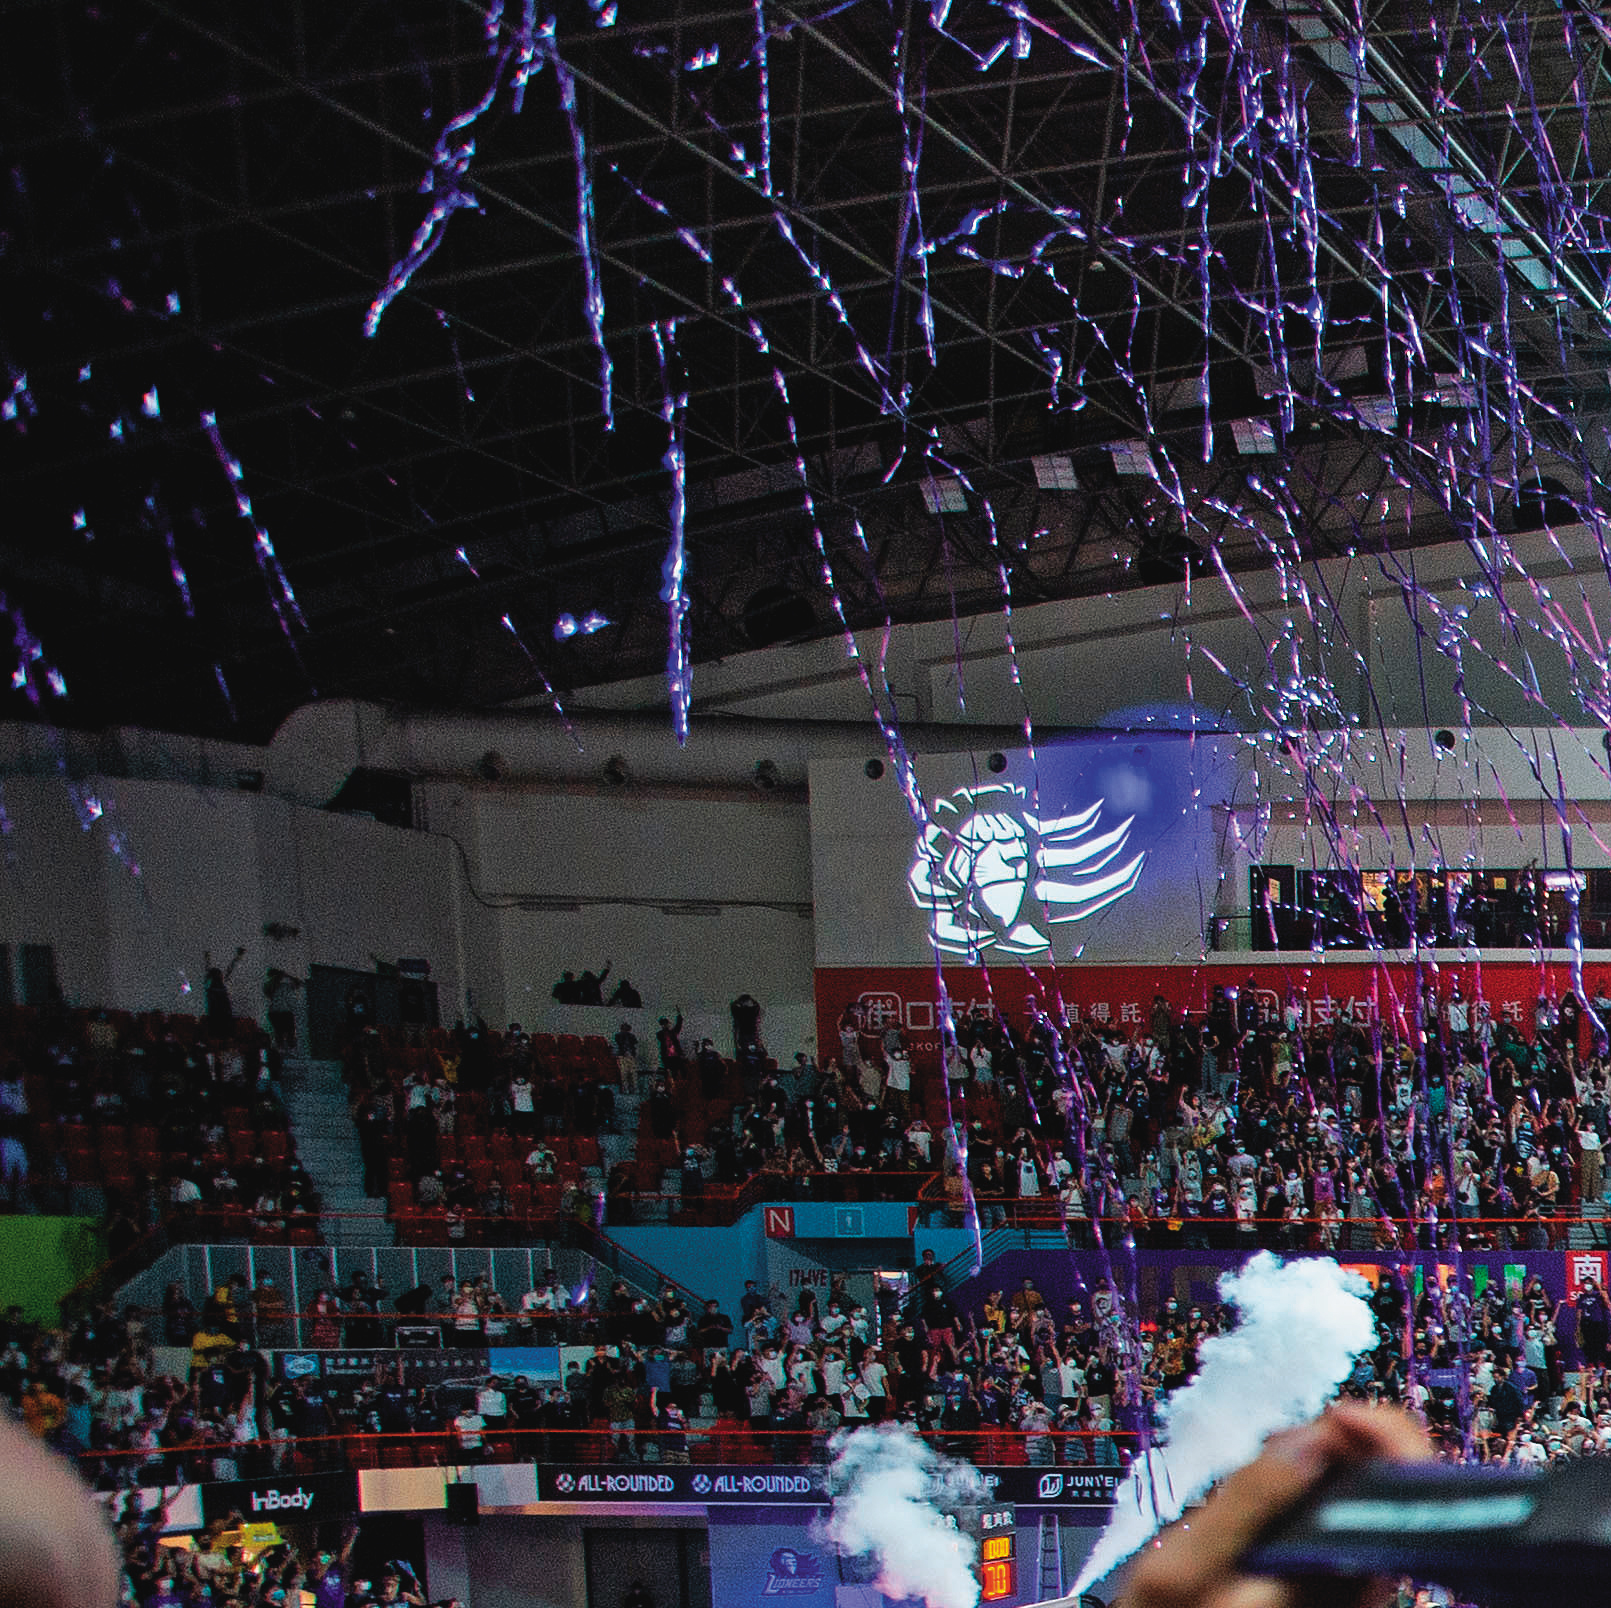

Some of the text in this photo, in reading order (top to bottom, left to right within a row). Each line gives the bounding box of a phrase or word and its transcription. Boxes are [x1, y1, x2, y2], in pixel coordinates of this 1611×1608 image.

[769, 1209, 790, 1232] N
[578, 1474, 675, 1493] ALL-ROUNDED
[714, 1475, 811, 1494] ALL-ROUNDED
[252, 1486, 314, 1511] InBody
[766, 1574, 822, 1594] LIONEERS
